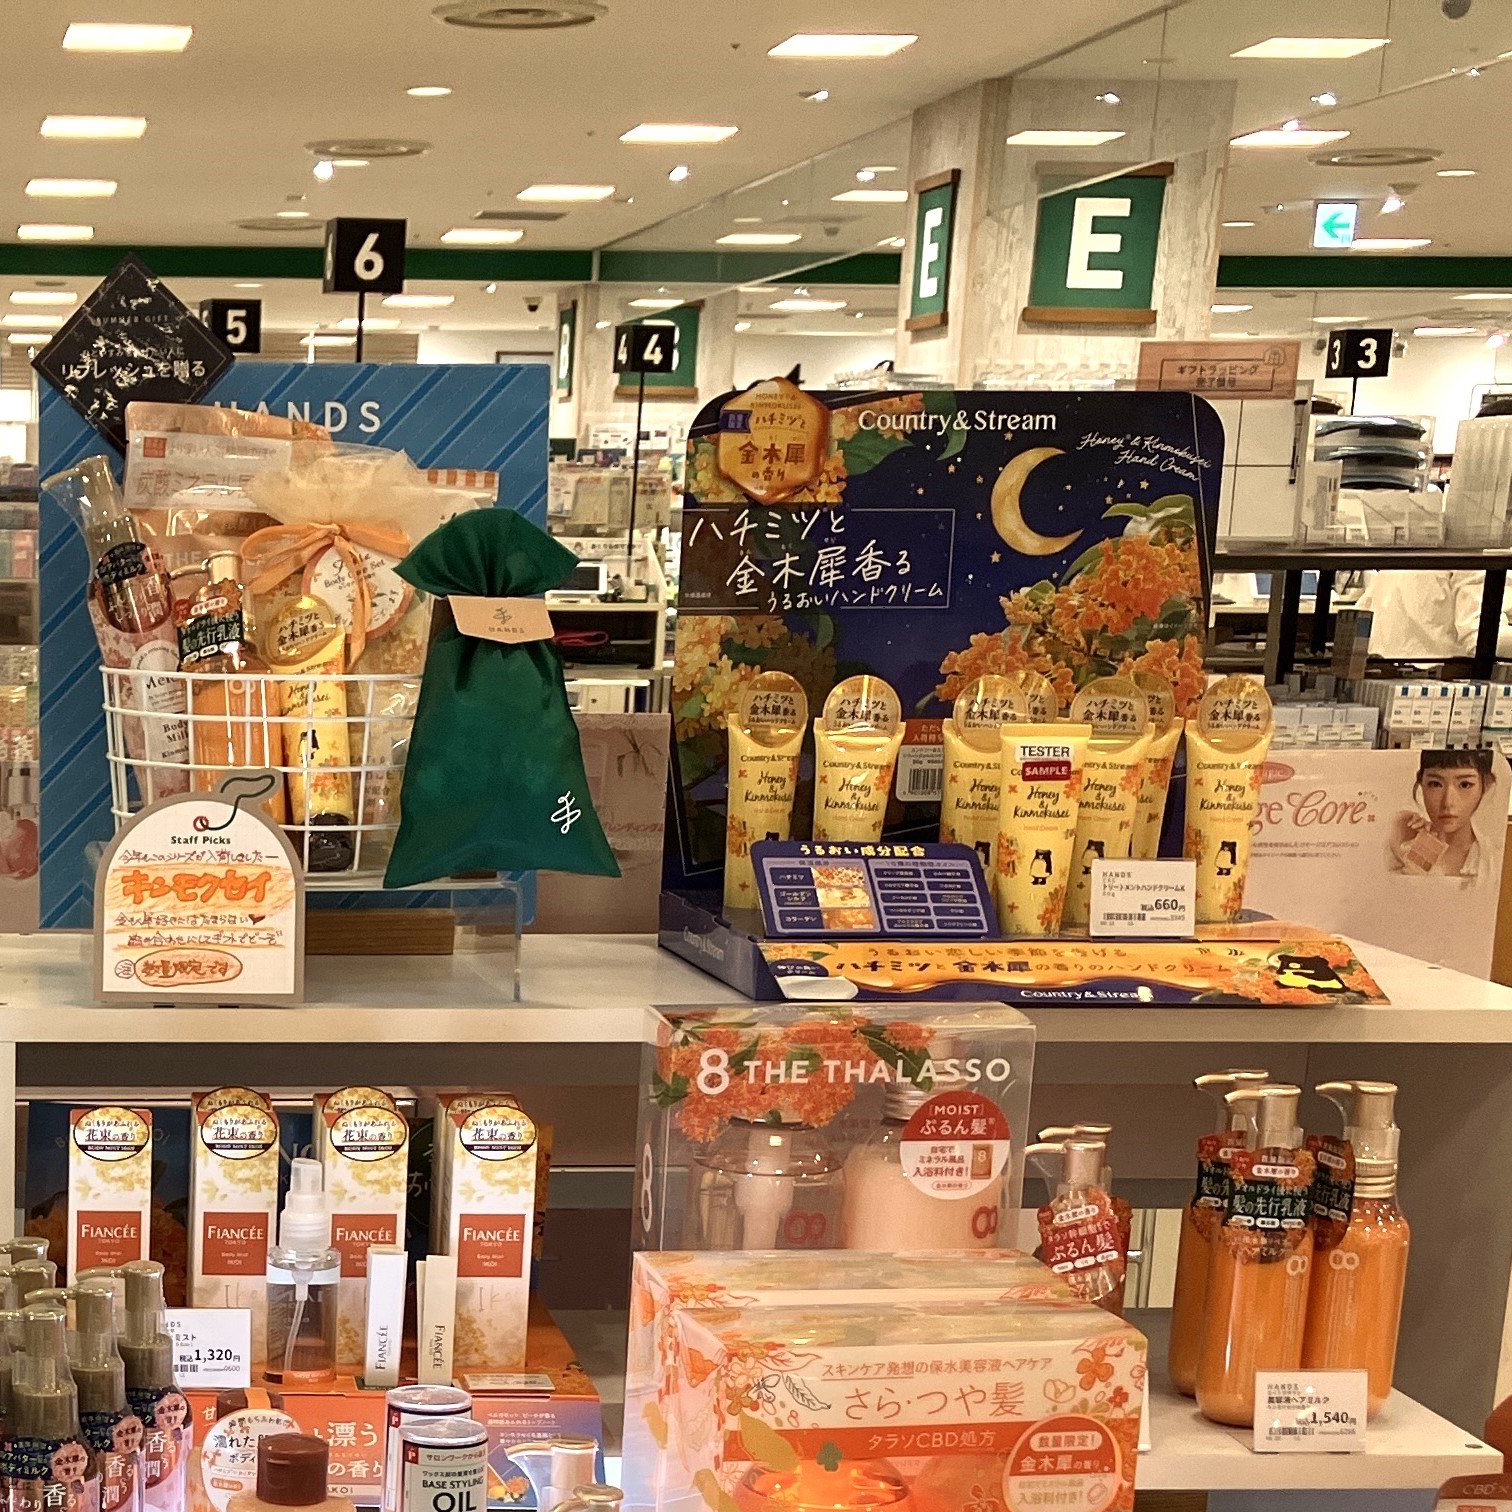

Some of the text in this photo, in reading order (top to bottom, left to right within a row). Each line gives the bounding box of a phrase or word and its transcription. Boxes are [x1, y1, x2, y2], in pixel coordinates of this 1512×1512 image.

[920, 207, 943, 298] E
[1066, 198, 1131, 290] E
[354, 233, 385, 280] 6
[226, 310, 247, 343] 5
[644, 333, 663, 365] 4
[1357, 338, 1377, 369] 3
[755, 412, 806, 430] ハチミツと
[739, 441, 805, 465] 金木犀
[752, 466, 785, 482] の香り
[1116, 448, 1203, 483] Hand Cream
[689, 508, 845, 547] ハチミツと
[727, 539, 911, 595] 金木犀香る
[768, 583, 943, 613] うるおいハンドクリーム
[1020, 745, 1070, 757] TESTER
[1025, 766, 1068, 776] SAMPLE
[839, 778, 871, 797] Honey
[1027, 786, 1059, 804] Honey
[1084, 778, 1117, 797] Honey
[1013, 805, 1071, 819] Kinmokusei
[171, 836, 231, 845] Staff Picks
[800, 845, 925, 857] うるおい成分配合
[122, 869, 271, 904] キンモクセイ
[1141, 899, 1186, 912] 税込660円
[696, 1048, 1010, 1094] 8 THE THALASSO
[86, 1128, 135, 1141] 花束の香り
[213, 1127, 263, 1140] 花束の香り
[343, 1128, 391, 1142] 花束の香り
[472, 1128, 521, 1142] 花束の香り
[920, 1117, 986, 1136] ぷるん髪
[917, 1155, 965, 1164] ミネラル風呂
[930, 1146, 955, 1155] 自宅で
[1233, 1195, 1306, 1216] 髪の先行乳液
[81, 1224, 137, 1239] FIANCÉE
[207, 1225, 264, 1240] FIANCÉE
[336, 1225, 392, 1241] FIANCÉE
[463, 1225, 520, 1242] FIANCÉE
[1050, 1237, 1114, 1262] ぷるん髪
[180, 1349, 240, 1363] 税込1,320円
[822, 1358, 1052, 1377] スキンケア発想の保水美容液ヘアケア
[868, 1431, 995, 1450] タラソCBD処方
[1020, 1455, 1100, 1472] 金木犀の香り
[422, 1477, 483, 1489] BASE STYLING
